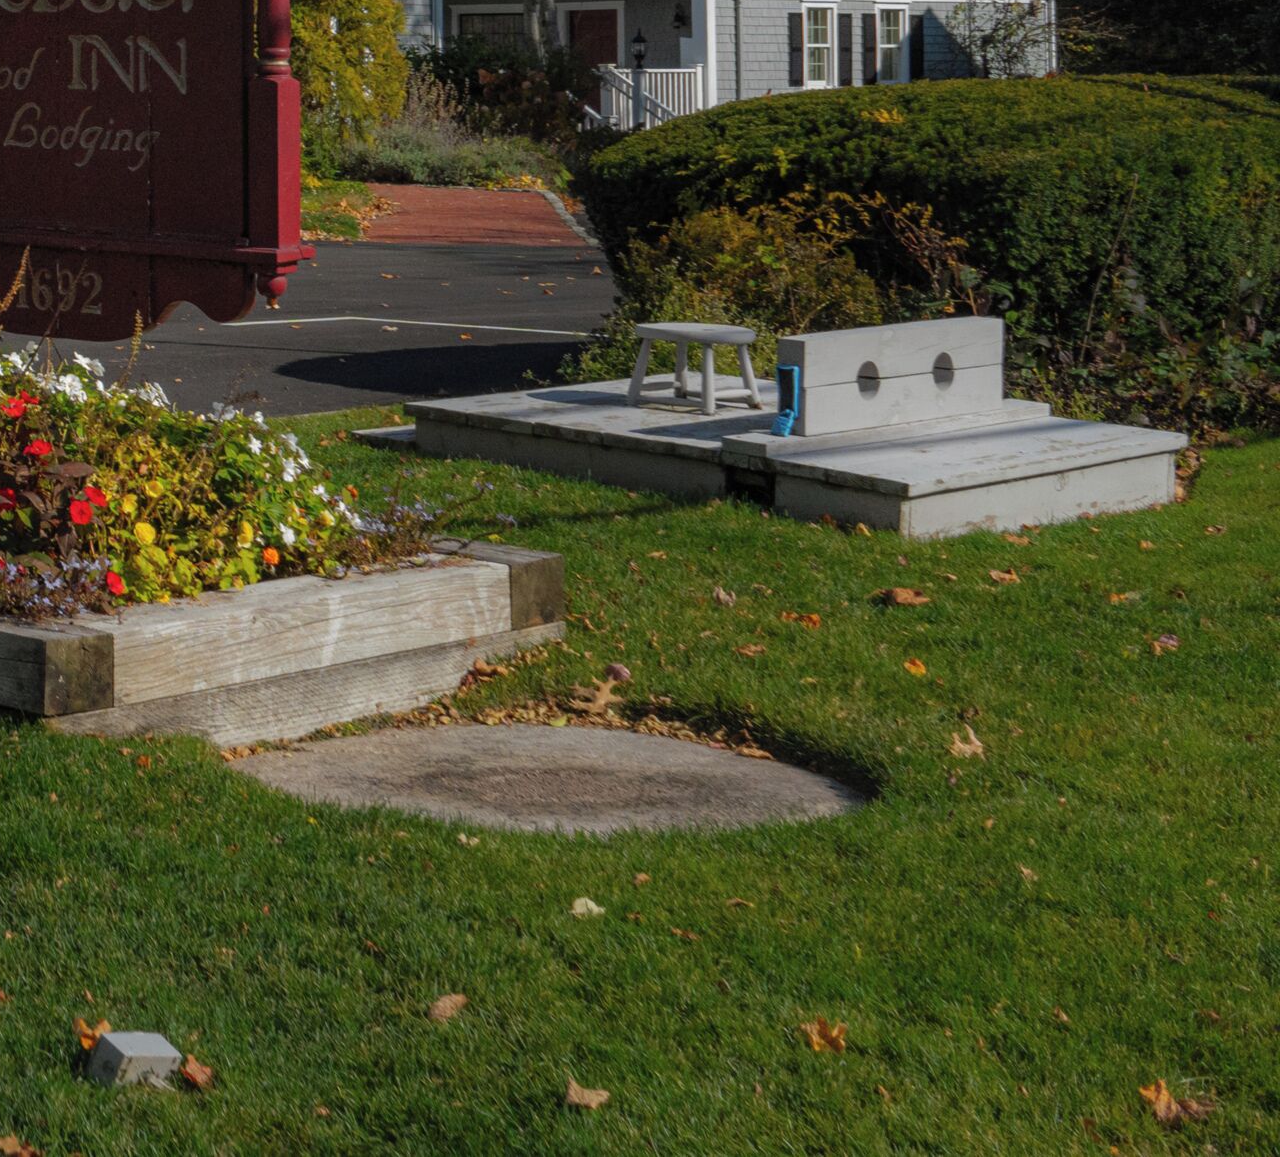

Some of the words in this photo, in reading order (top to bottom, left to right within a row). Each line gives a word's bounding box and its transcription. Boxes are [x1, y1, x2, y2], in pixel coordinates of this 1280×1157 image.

[67, 33, 188, 95] INN
[2, 101, 161, 172] Lodging
[14, 267, 103, 315] 1692
